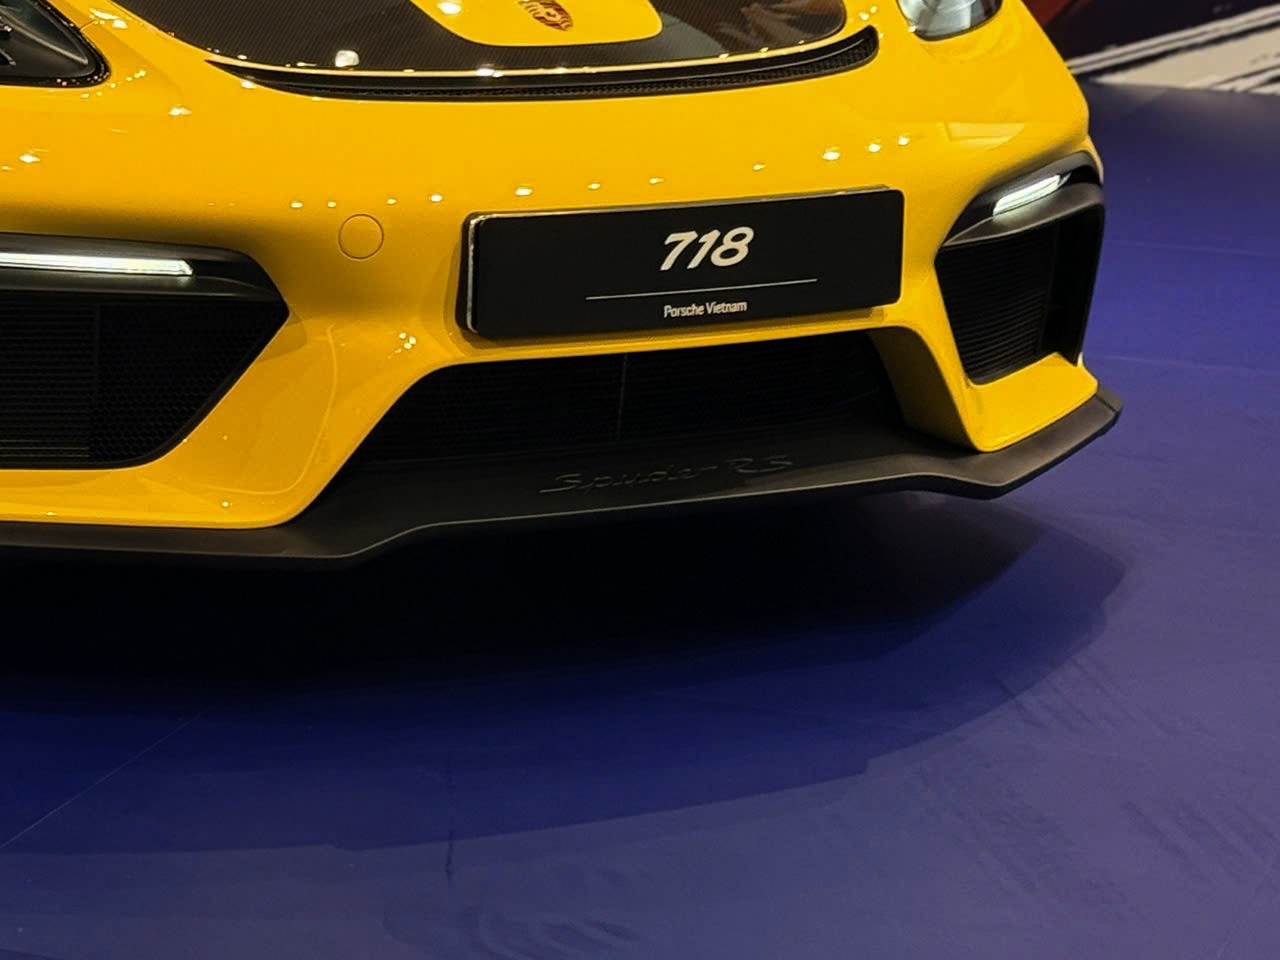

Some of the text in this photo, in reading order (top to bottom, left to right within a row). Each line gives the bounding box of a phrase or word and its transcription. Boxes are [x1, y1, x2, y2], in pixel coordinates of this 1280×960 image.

[659, 226, 754, 271] 718
[663, 301, 748, 318] Porsche Vietnam
